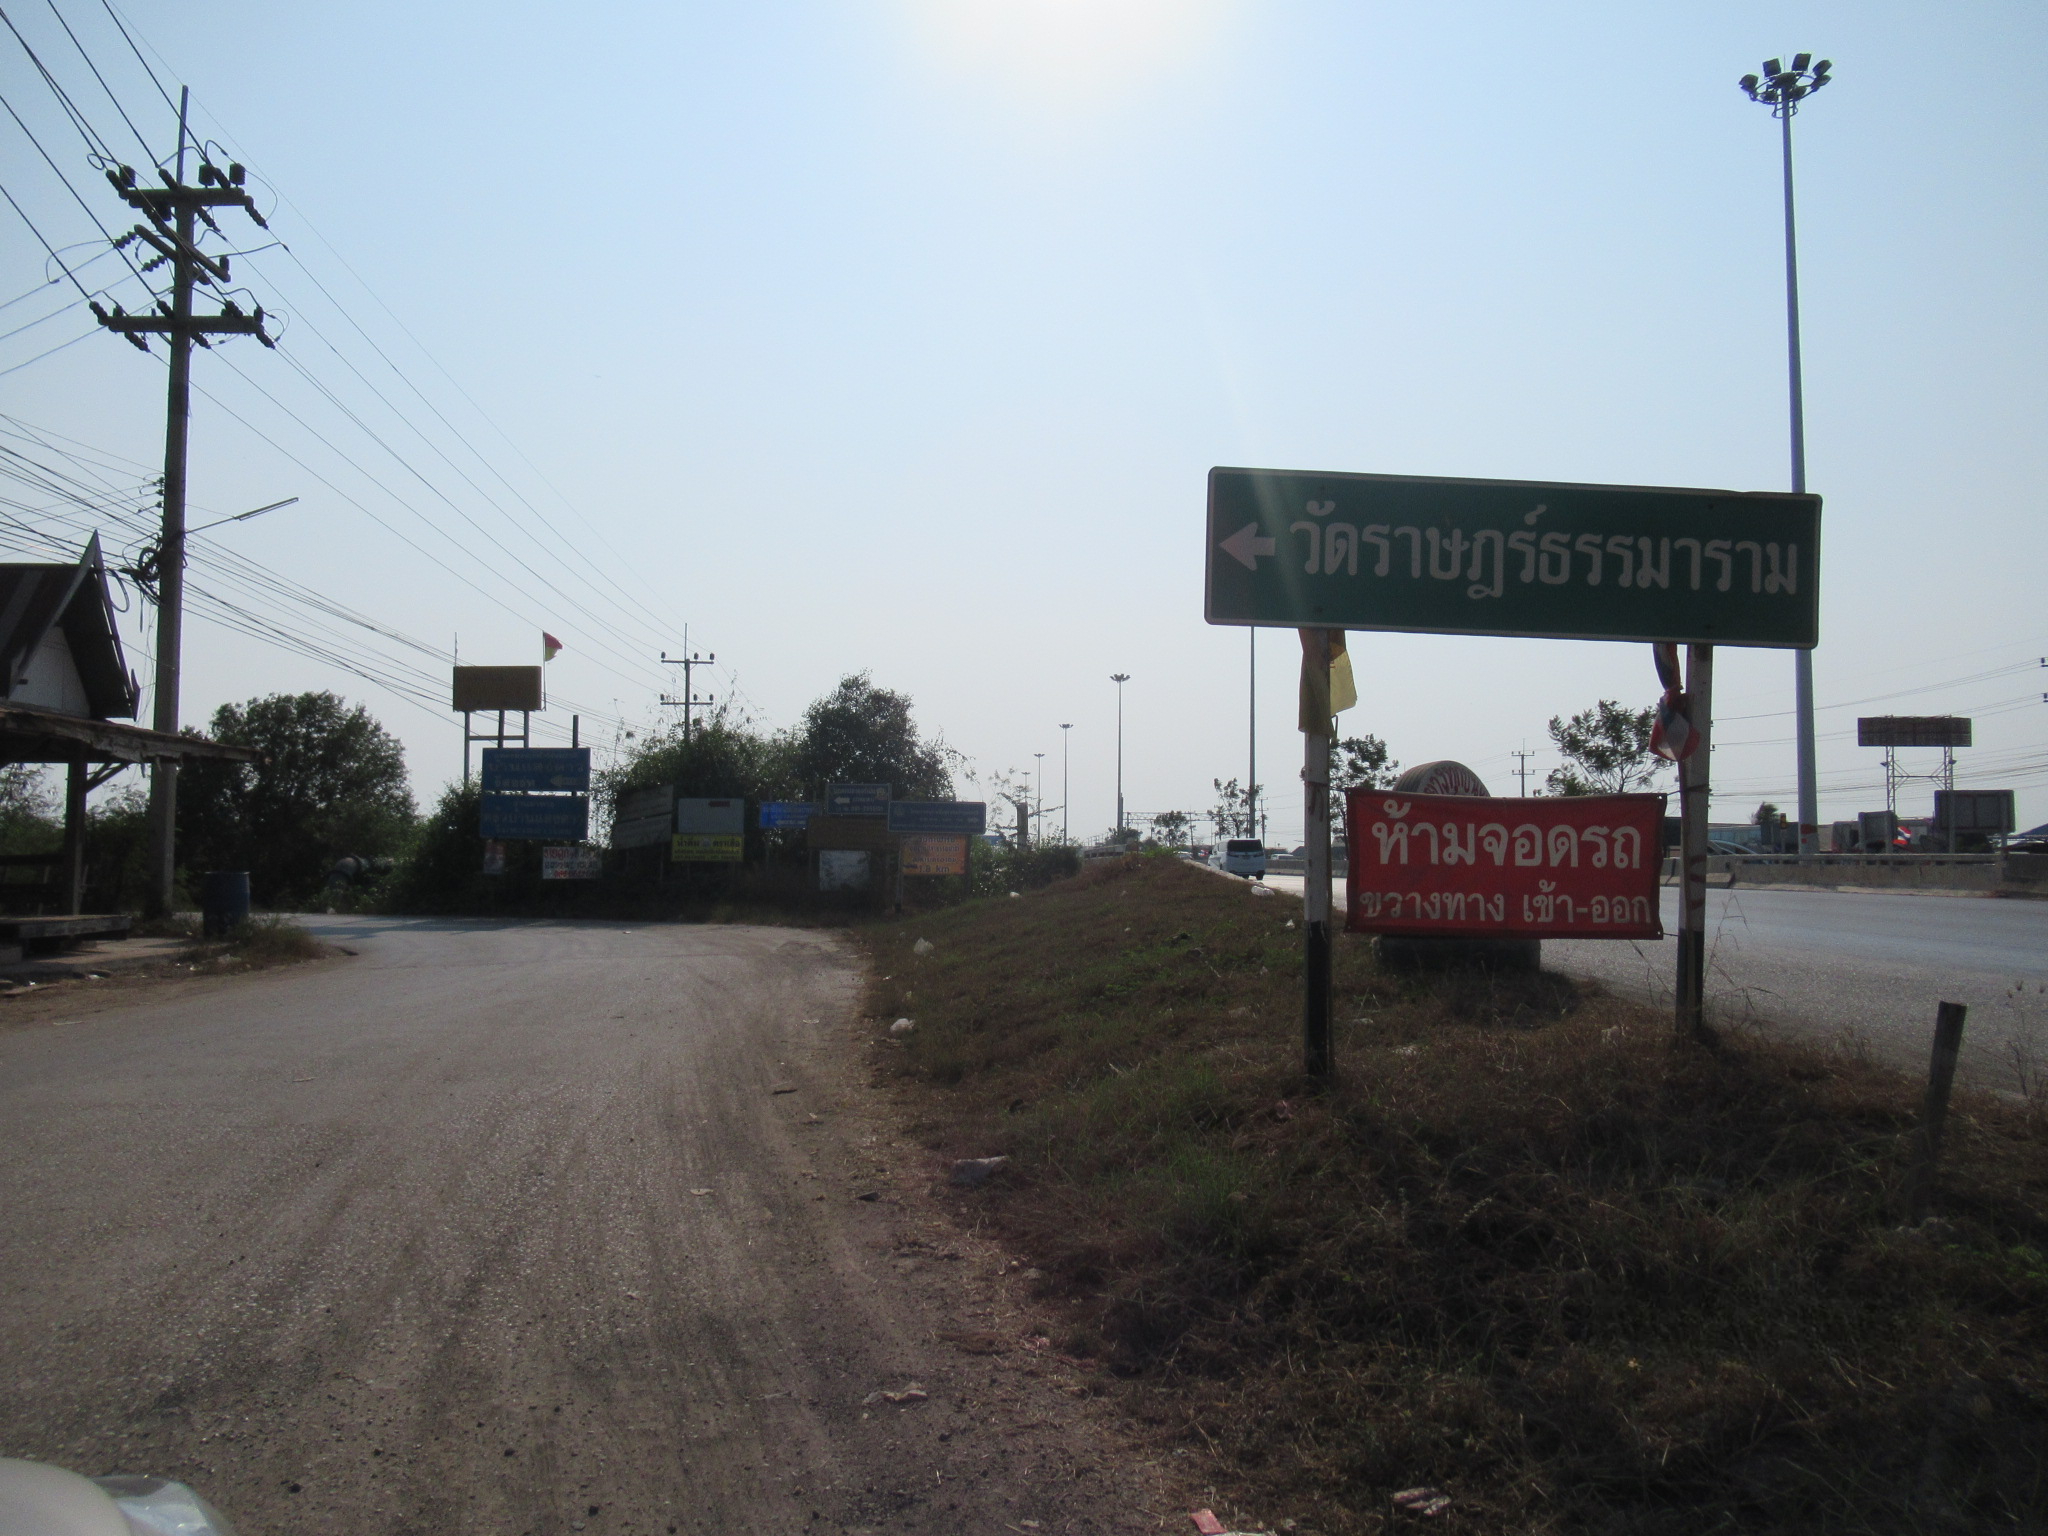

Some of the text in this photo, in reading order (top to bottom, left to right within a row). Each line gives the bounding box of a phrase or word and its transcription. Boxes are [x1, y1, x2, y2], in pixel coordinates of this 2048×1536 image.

[1288, 500, 1798, 599] วัดราษฎร์ธรรมาราม
[1371, 799, 1642, 869] ห้ามจอดรถ
[1360, 879, 1651, 924] ขวางทาง เข้า-ออก
